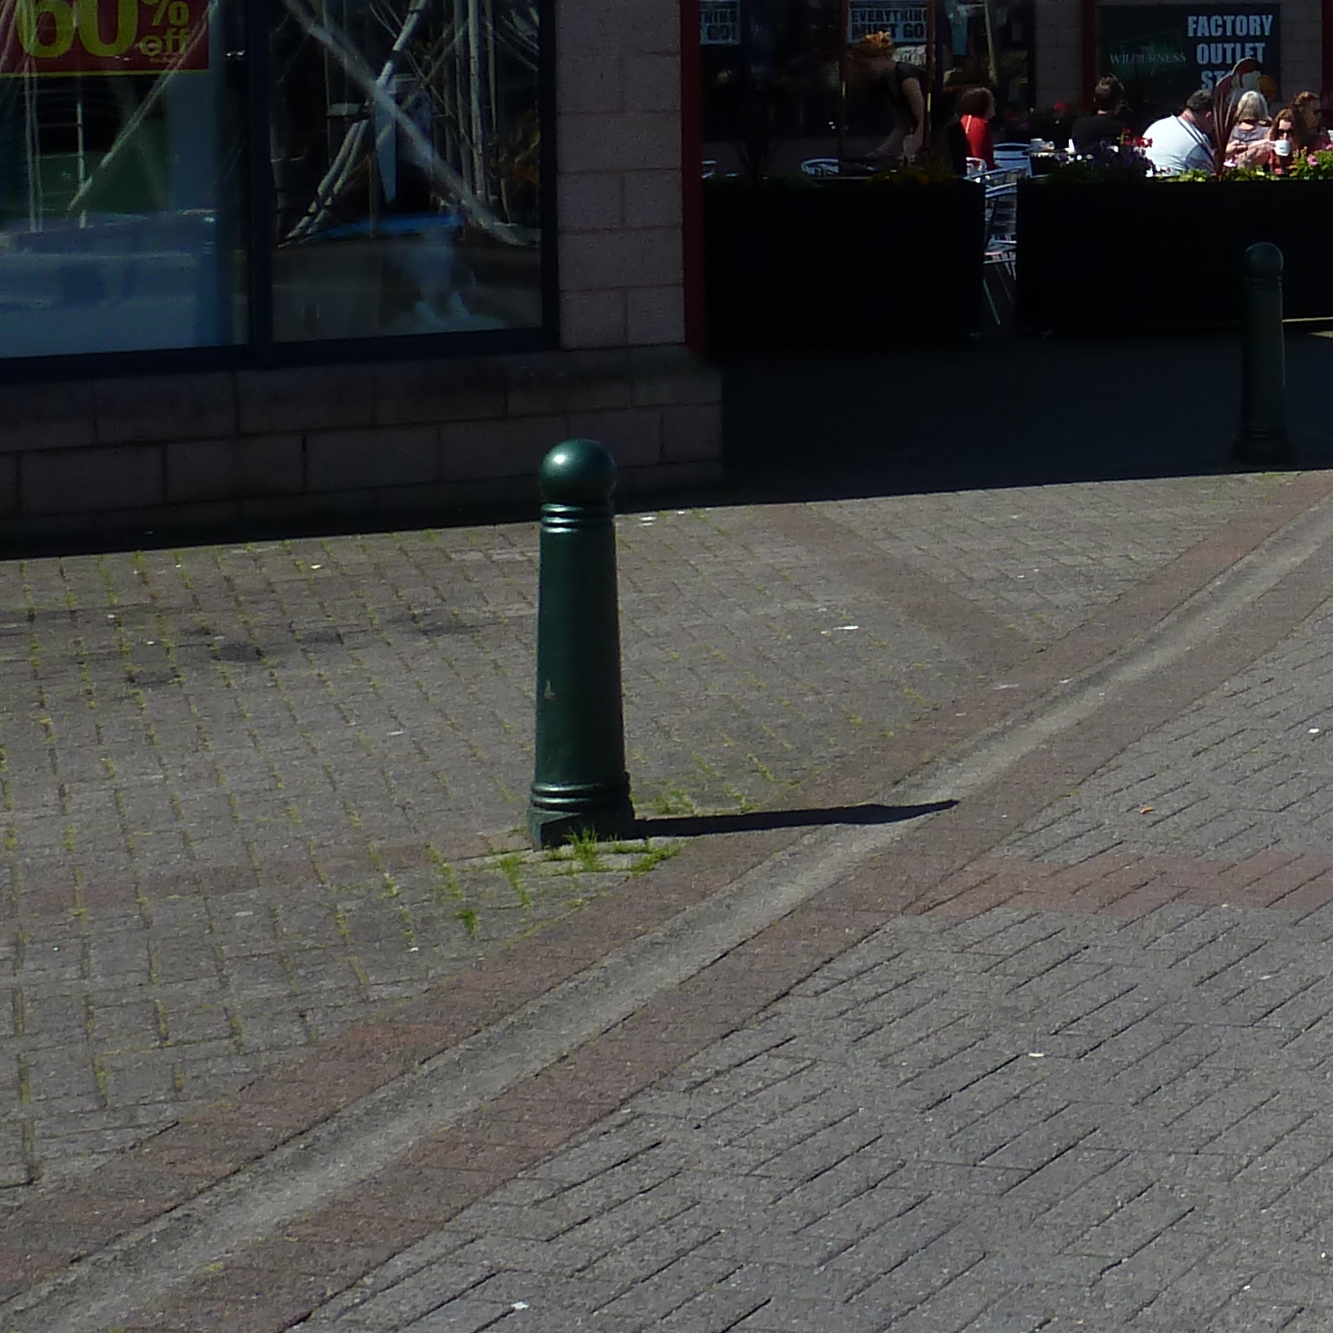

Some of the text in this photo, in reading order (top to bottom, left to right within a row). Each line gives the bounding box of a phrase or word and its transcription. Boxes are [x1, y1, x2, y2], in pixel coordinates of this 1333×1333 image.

[1187, 14, 1274, 37] FACTORY
[138, 27, 188, 56] off
[1196, 42, 1266, 65] OUTLET
